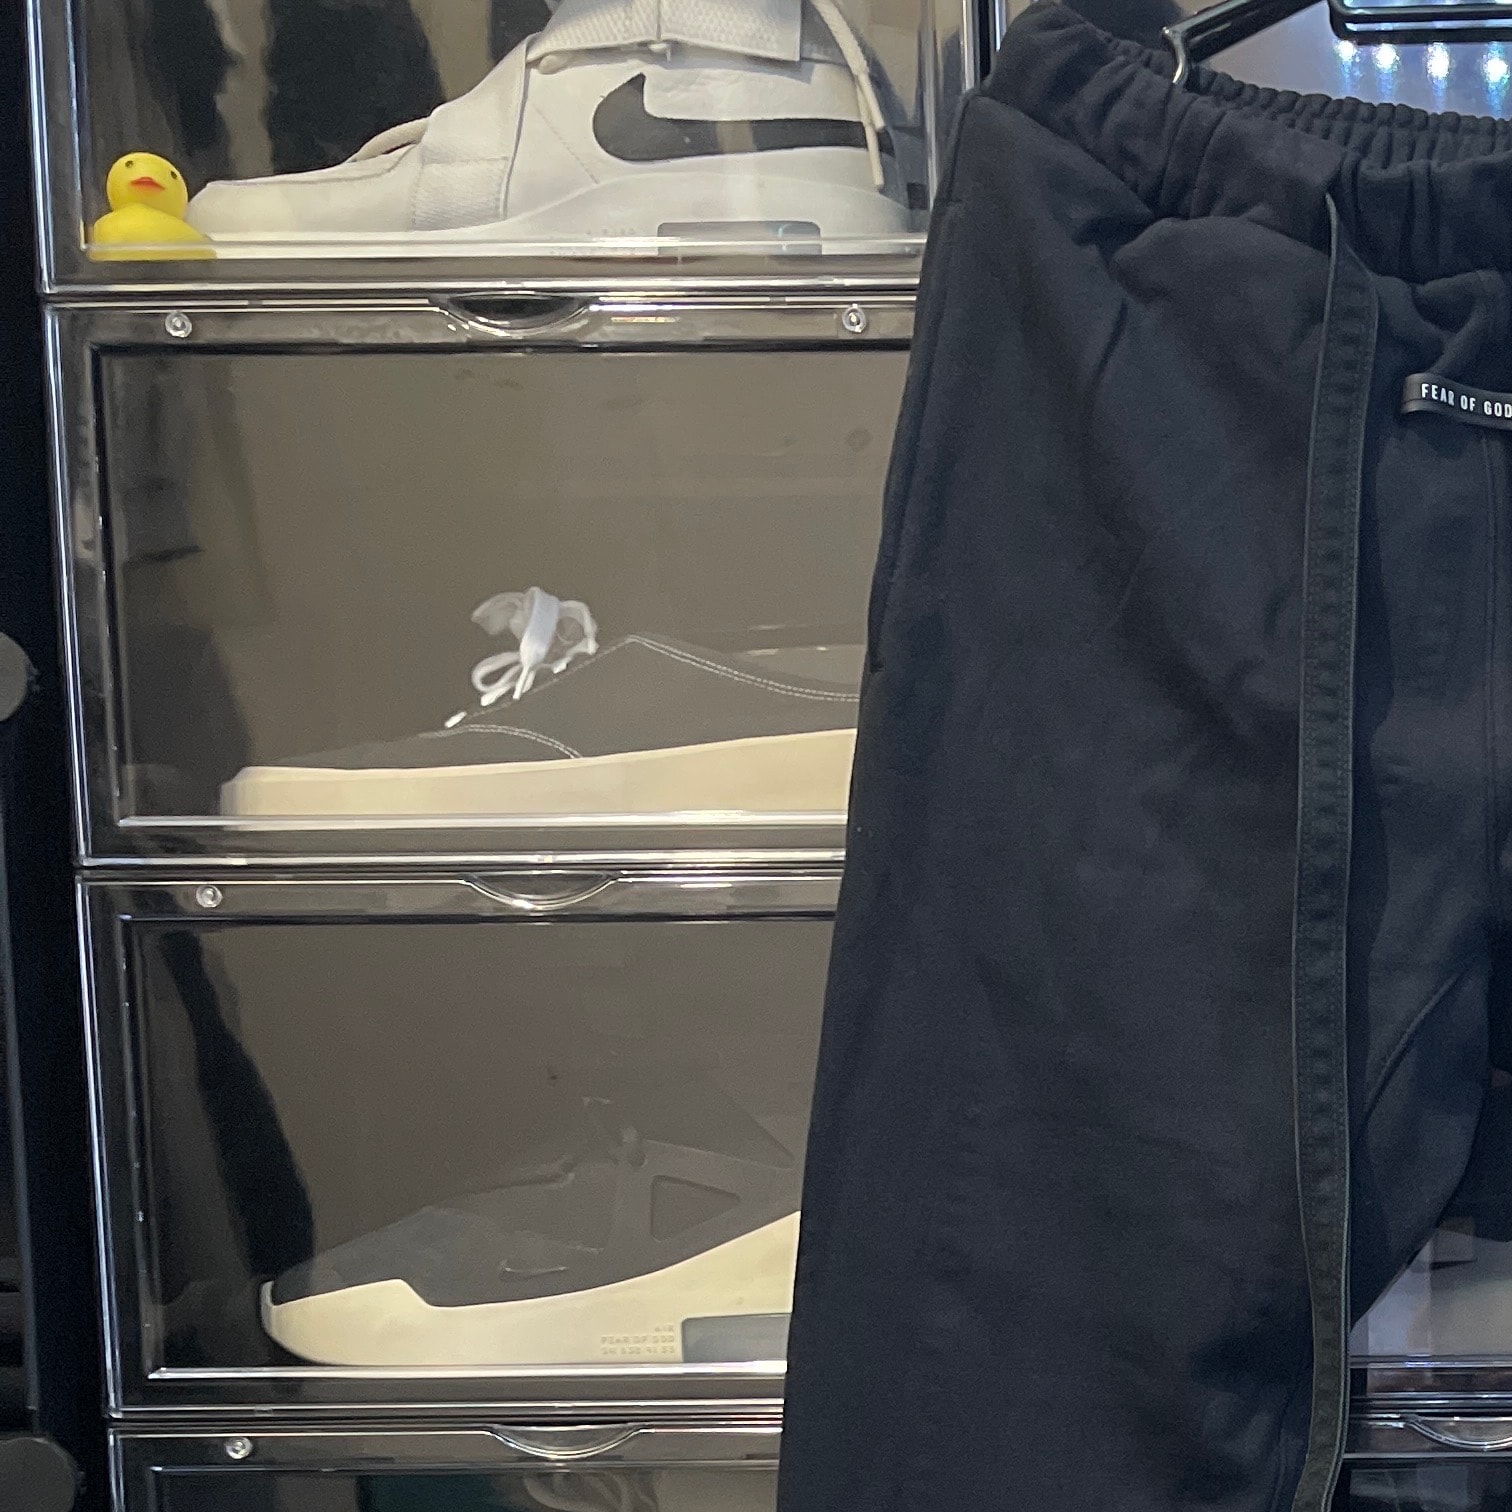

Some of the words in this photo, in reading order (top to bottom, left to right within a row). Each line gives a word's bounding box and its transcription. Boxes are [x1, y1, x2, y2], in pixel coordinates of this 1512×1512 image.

[1421, 383, 1455, 406] FEAR
[1460, 395, 1476, 411] OF
[1483, 401, 1512, 418] GOD
